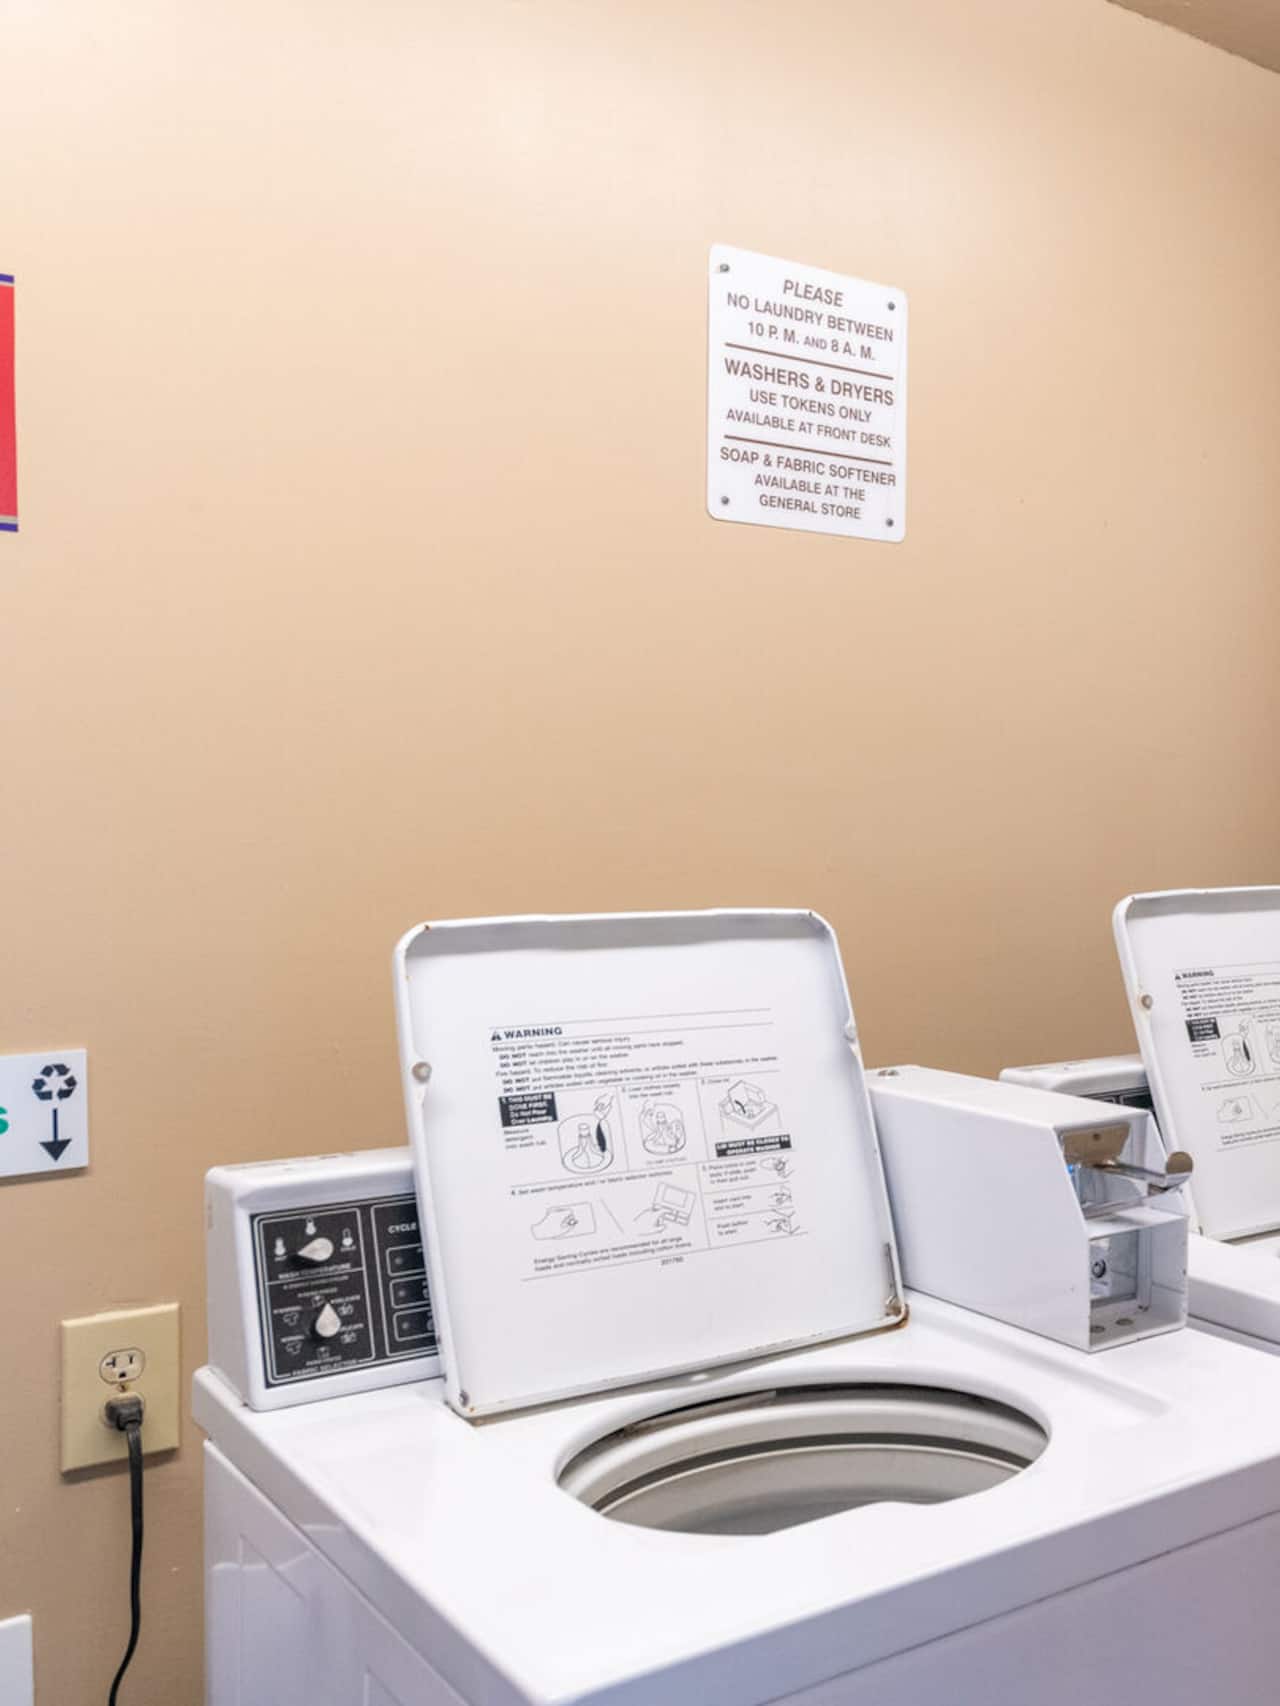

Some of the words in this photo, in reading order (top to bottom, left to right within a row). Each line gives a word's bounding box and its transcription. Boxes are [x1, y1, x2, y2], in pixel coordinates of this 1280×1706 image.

[783, 279, 843, 307] PLEASE
[727, 292, 750, 311] NO
[754, 298, 823, 326] LAUNDRY
[827, 315, 893, 342] BETWEEN
[748, 321, 764, 336] 10
[804, 335, 828, 350] AND
[831, 339, 839, 352] 8
[724, 357, 809, 389] WASHERS
[814, 377, 826, 392] &
[831, 380, 894, 406] DRYERS
[750, 389, 776, 406] USE
[782, 395, 835, 417] TOKENS
[839, 406, 872, 423] ONLY
[726, 408, 794, 432] AVAILABLE
[798, 421, 812, 434] AT
[817, 423, 857, 442] FRONT
[860, 432, 891, 448] DESK
[720, 446, 759, 465] SOAP
[763, 454, 772, 468] &
[776, 455, 825, 476] FABRIC
[829, 464, 896, 487] SOFTENER
[754, 474, 821, 495] AVAILABLE
[824, 484, 839, 497] AT
[843, 486, 865, 501] THE
[759, 495, 817, 514] GENERAL
[821, 504, 861, 520] STORE
[504, 1026, 562, 1039] WARNING
[388, 1222, 417, 1234] CYCLE
